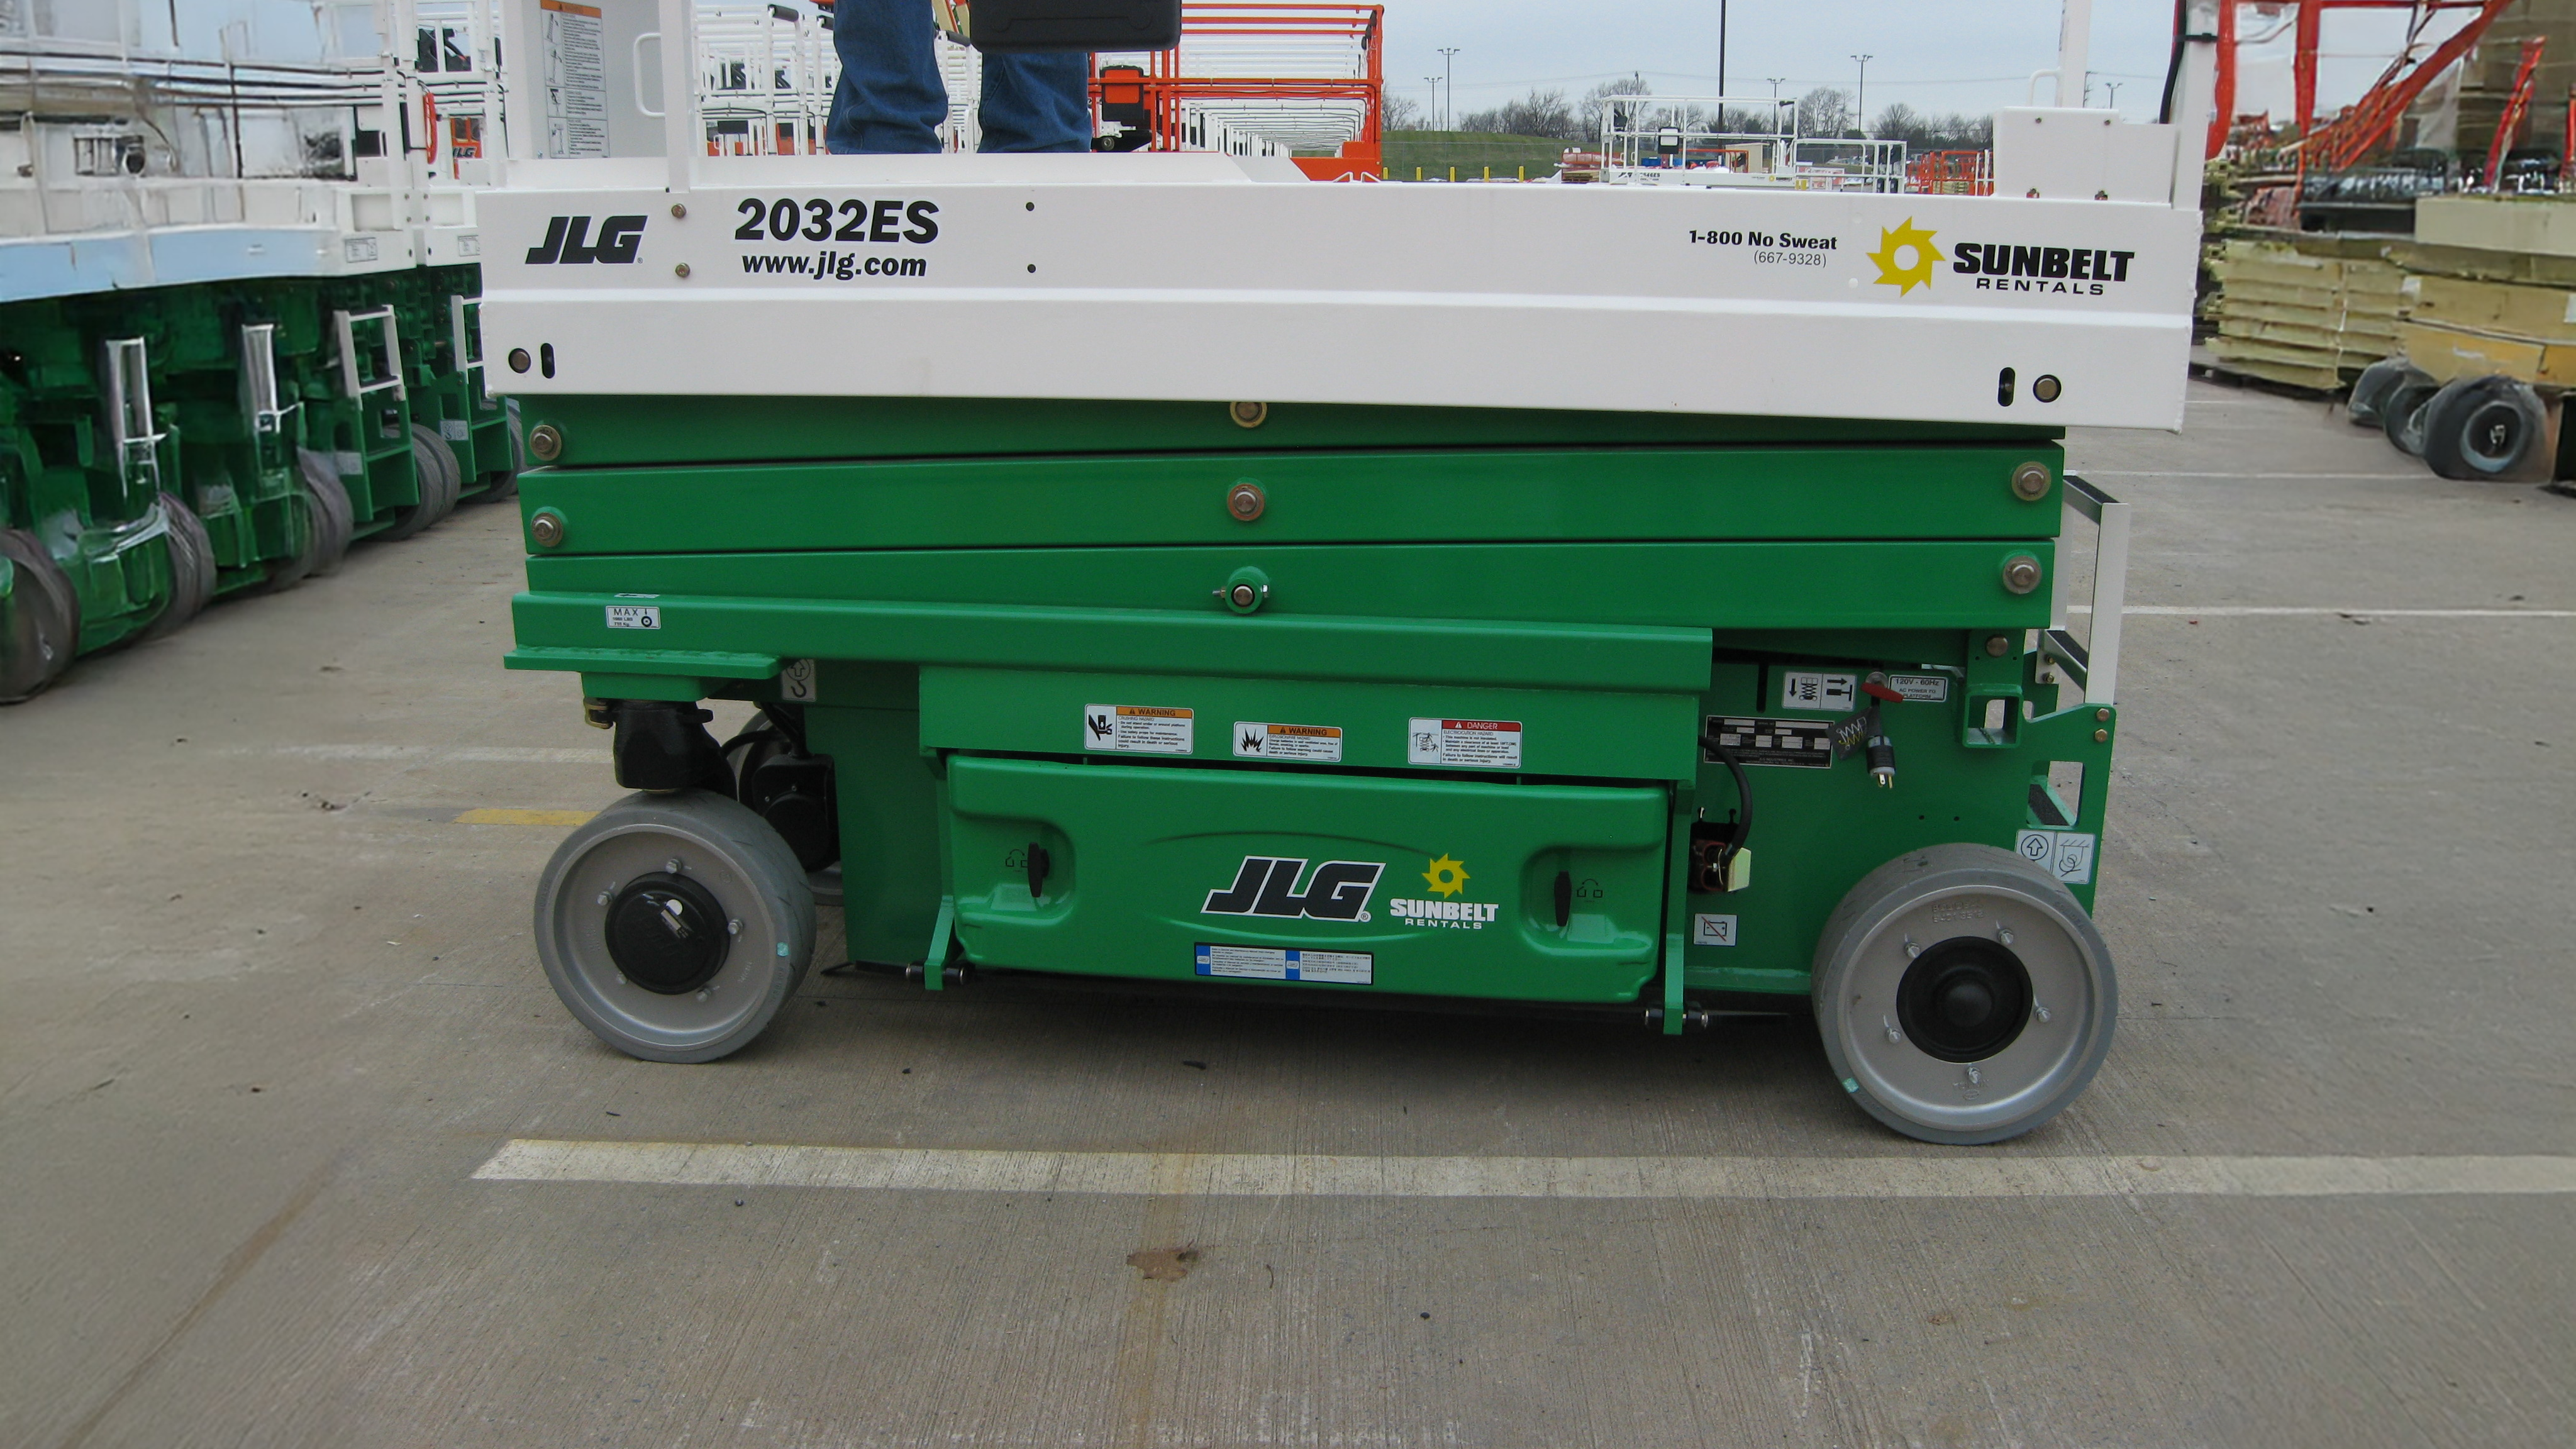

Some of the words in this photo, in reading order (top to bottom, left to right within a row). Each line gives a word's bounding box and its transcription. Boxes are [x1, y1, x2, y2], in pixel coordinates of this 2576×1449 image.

[735, 198, 940, 244] 2032ES
[525, 215, 648, 265] JLG
[1689, 230, 1743, 245] 1-800
[1748, 231, 1774, 247] No
[1779, 232, 1837, 250] Sweat
[741, 250, 926, 280] www.jlg.com
[1753, 249, 1827, 268] (667-9328)
[1953, 242, 2135, 282] SUNBELT
[1976, 277, 2103, 296] RENTALS
[614, 608, 638, 616] MAX
[1138, 708, 1175, 716] WARNING
[1289, 727, 1327, 736] WARNING
[1467, 721, 1498, 730] DANGER
[1201, 855, 1387, 922] JLG
[1390, 898, 1499, 922] SUNBELT
[1404, 918, 1482, 930] RENTALS
